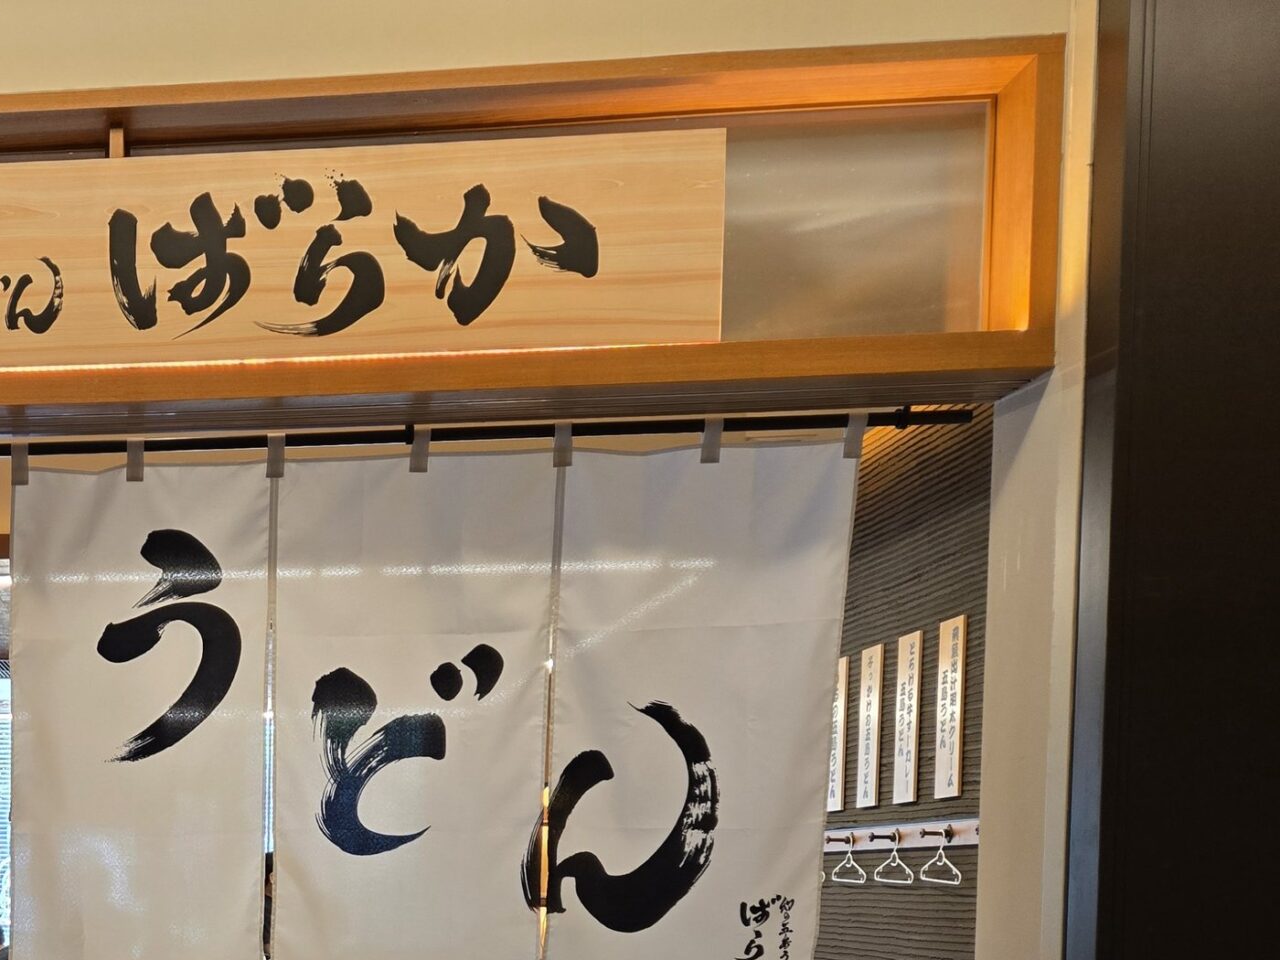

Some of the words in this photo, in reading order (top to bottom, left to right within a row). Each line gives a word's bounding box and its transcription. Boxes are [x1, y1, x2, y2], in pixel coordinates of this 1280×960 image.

[109, 167, 600, 339] ばらか
[96, 528, 718, 933] うどん
